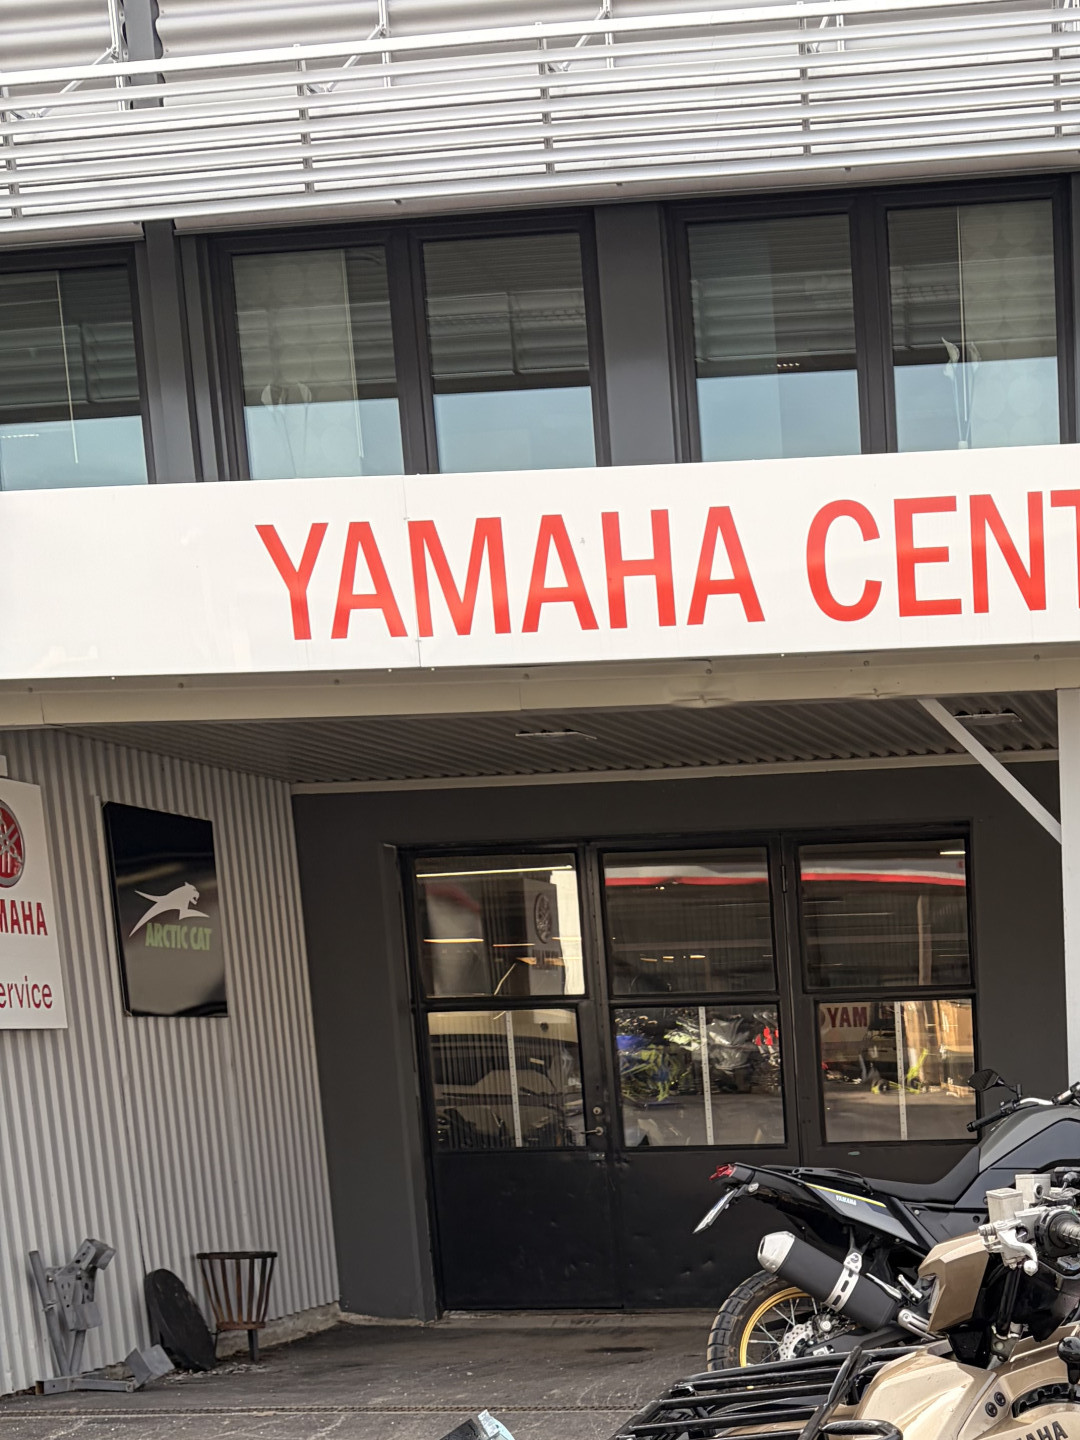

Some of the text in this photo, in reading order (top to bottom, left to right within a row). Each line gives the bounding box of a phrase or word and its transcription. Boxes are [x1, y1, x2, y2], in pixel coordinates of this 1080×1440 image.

[256, 507, 764, 640] YAMAHA
[145, 923, 212, 950] ARCTIC CAT
